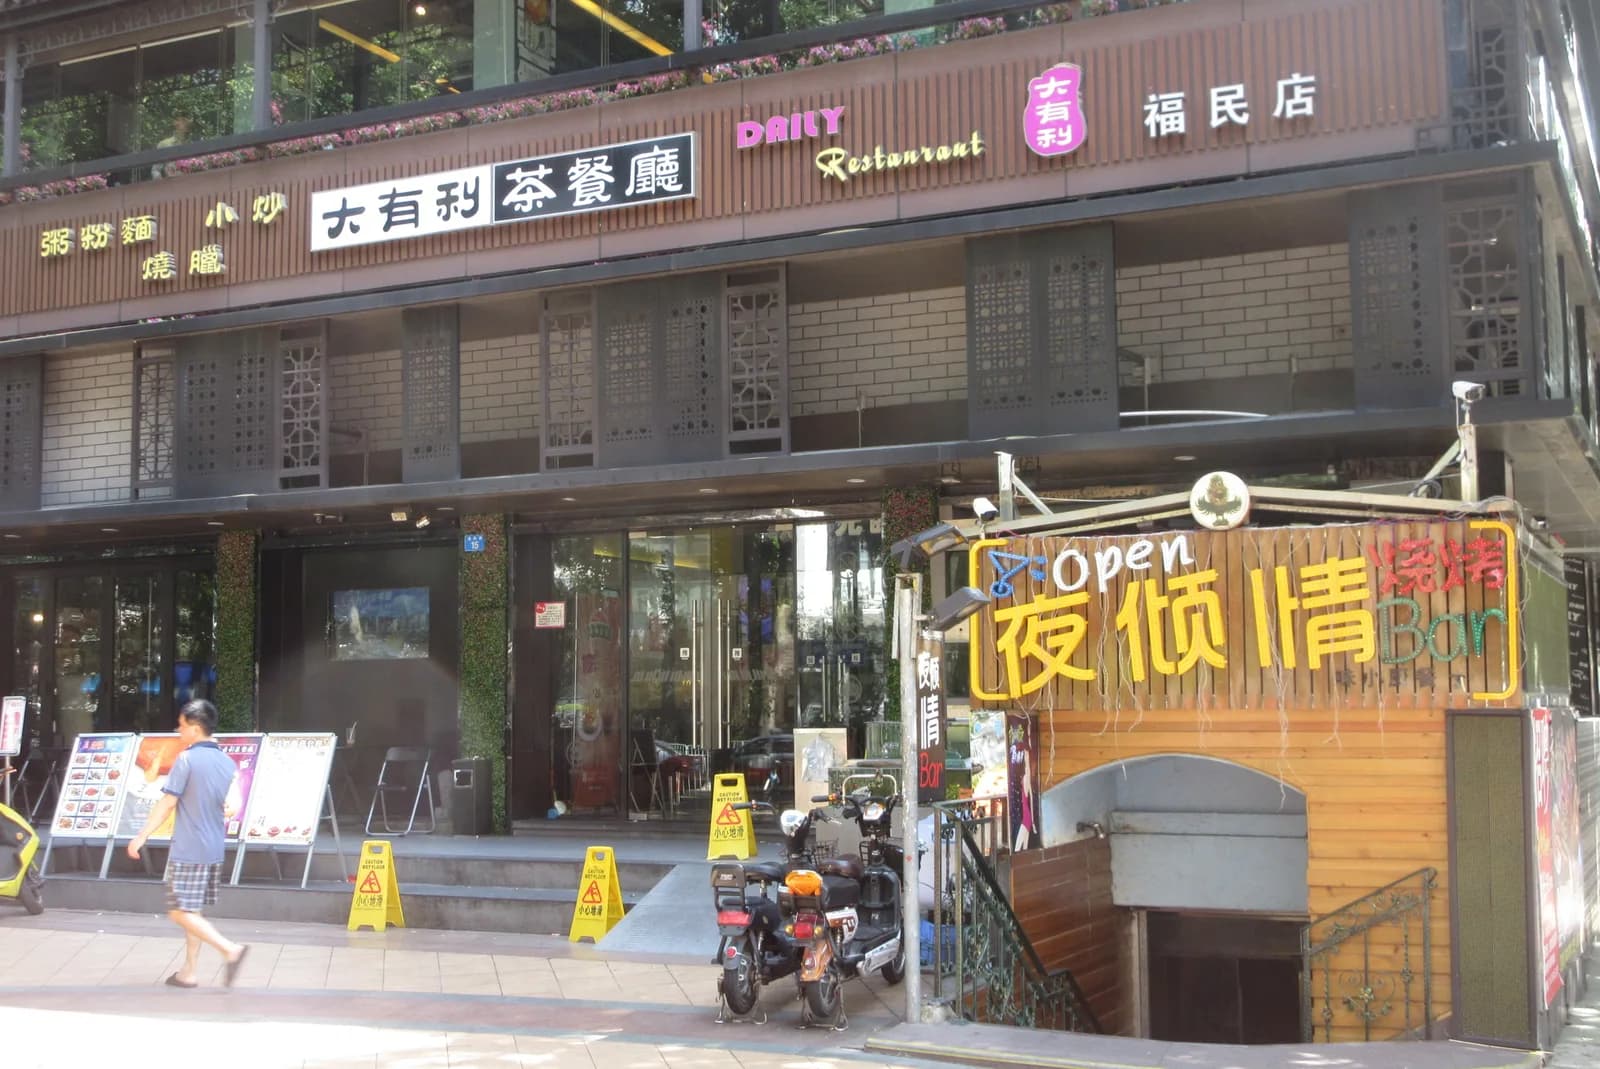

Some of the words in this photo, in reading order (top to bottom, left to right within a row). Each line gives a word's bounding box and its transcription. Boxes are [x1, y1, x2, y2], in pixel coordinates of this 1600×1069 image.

[736, 106, 845, 149] DAILY
[1034, 76, 1073, 149] 大有利
[1143, 73, 1316, 138] 福民店
[815, 130, 985, 182] Restaurant
[205, 192, 287, 229] 小炒
[322, 175, 481, 239] 大有利
[502, 146, 684, 213] 茶餐廳
[41, 215, 157, 257] 粥粉麵
[1052, 535, 1195, 592] Open
[1366, 537, 1505, 594] 烧烤
[994, 556, 1376, 699] 夜倾情
[1376, 596, 1508, 664] Bar
[919, 752, 943, 788] Bar
[714, 825, 744, 839] 小心地滑
